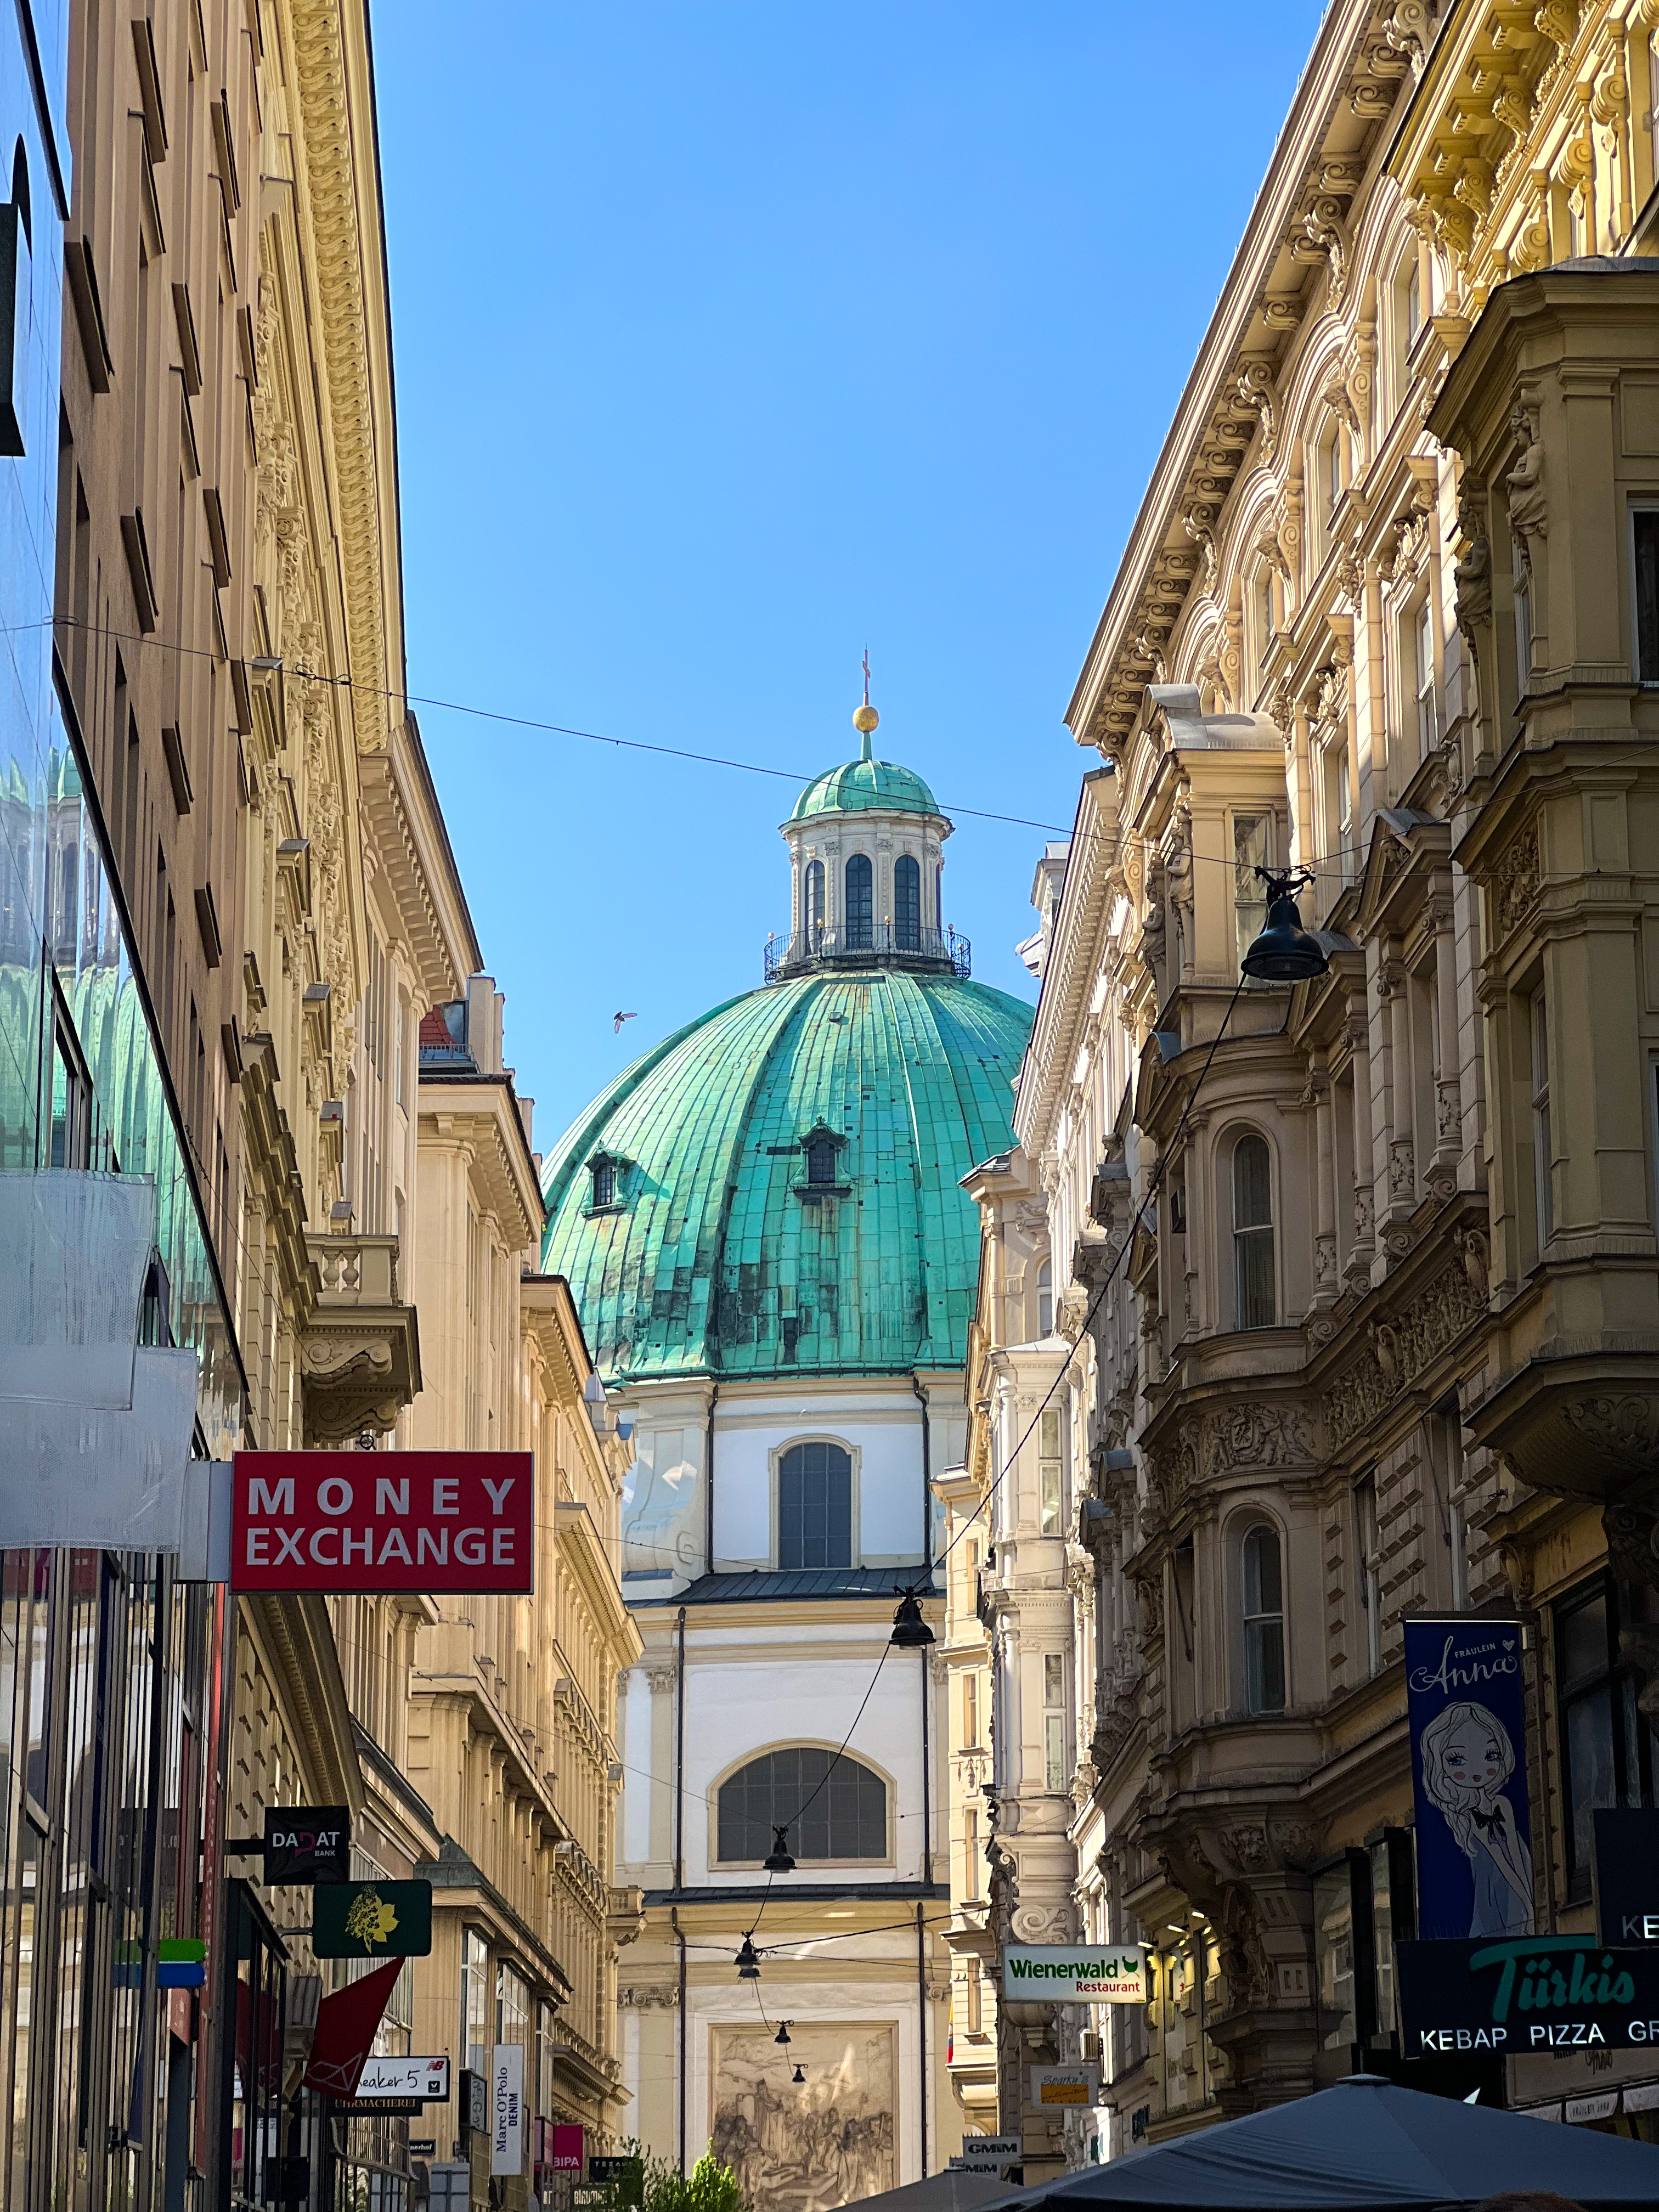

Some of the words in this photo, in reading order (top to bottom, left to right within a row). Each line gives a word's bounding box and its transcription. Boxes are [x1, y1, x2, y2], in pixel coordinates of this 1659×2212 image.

[249, 1477, 516, 1515] MONEY
[246, 1527, 515, 1565] EXCHANGE
[1409, 1635, 1517, 1695] Anna
[1454, 1643, 1496, 1658] FRÄULEIN
[273, 1832, 340, 1856] DADAT
[1008, 1959, 1118, 1979] Wienerwald
[1469, 1936, 1635, 2023] Türkis
[1076, 1981, 1140, 1992] Restaurant
[1420, 2028, 1507, 2051] KEBAP
[1530, 2023, 1606, 2046] PIZZA
[359, 2067, 403, 2090] eaker
[407, 2070, 421, 2089] 5
[497, 2067, 507, 2112] O'Polo
[509, 2093, 518, 2127] DENIM
[496, 2115, 507, 2153] Marc
[554, 2157, 579, 2167] BIPA
